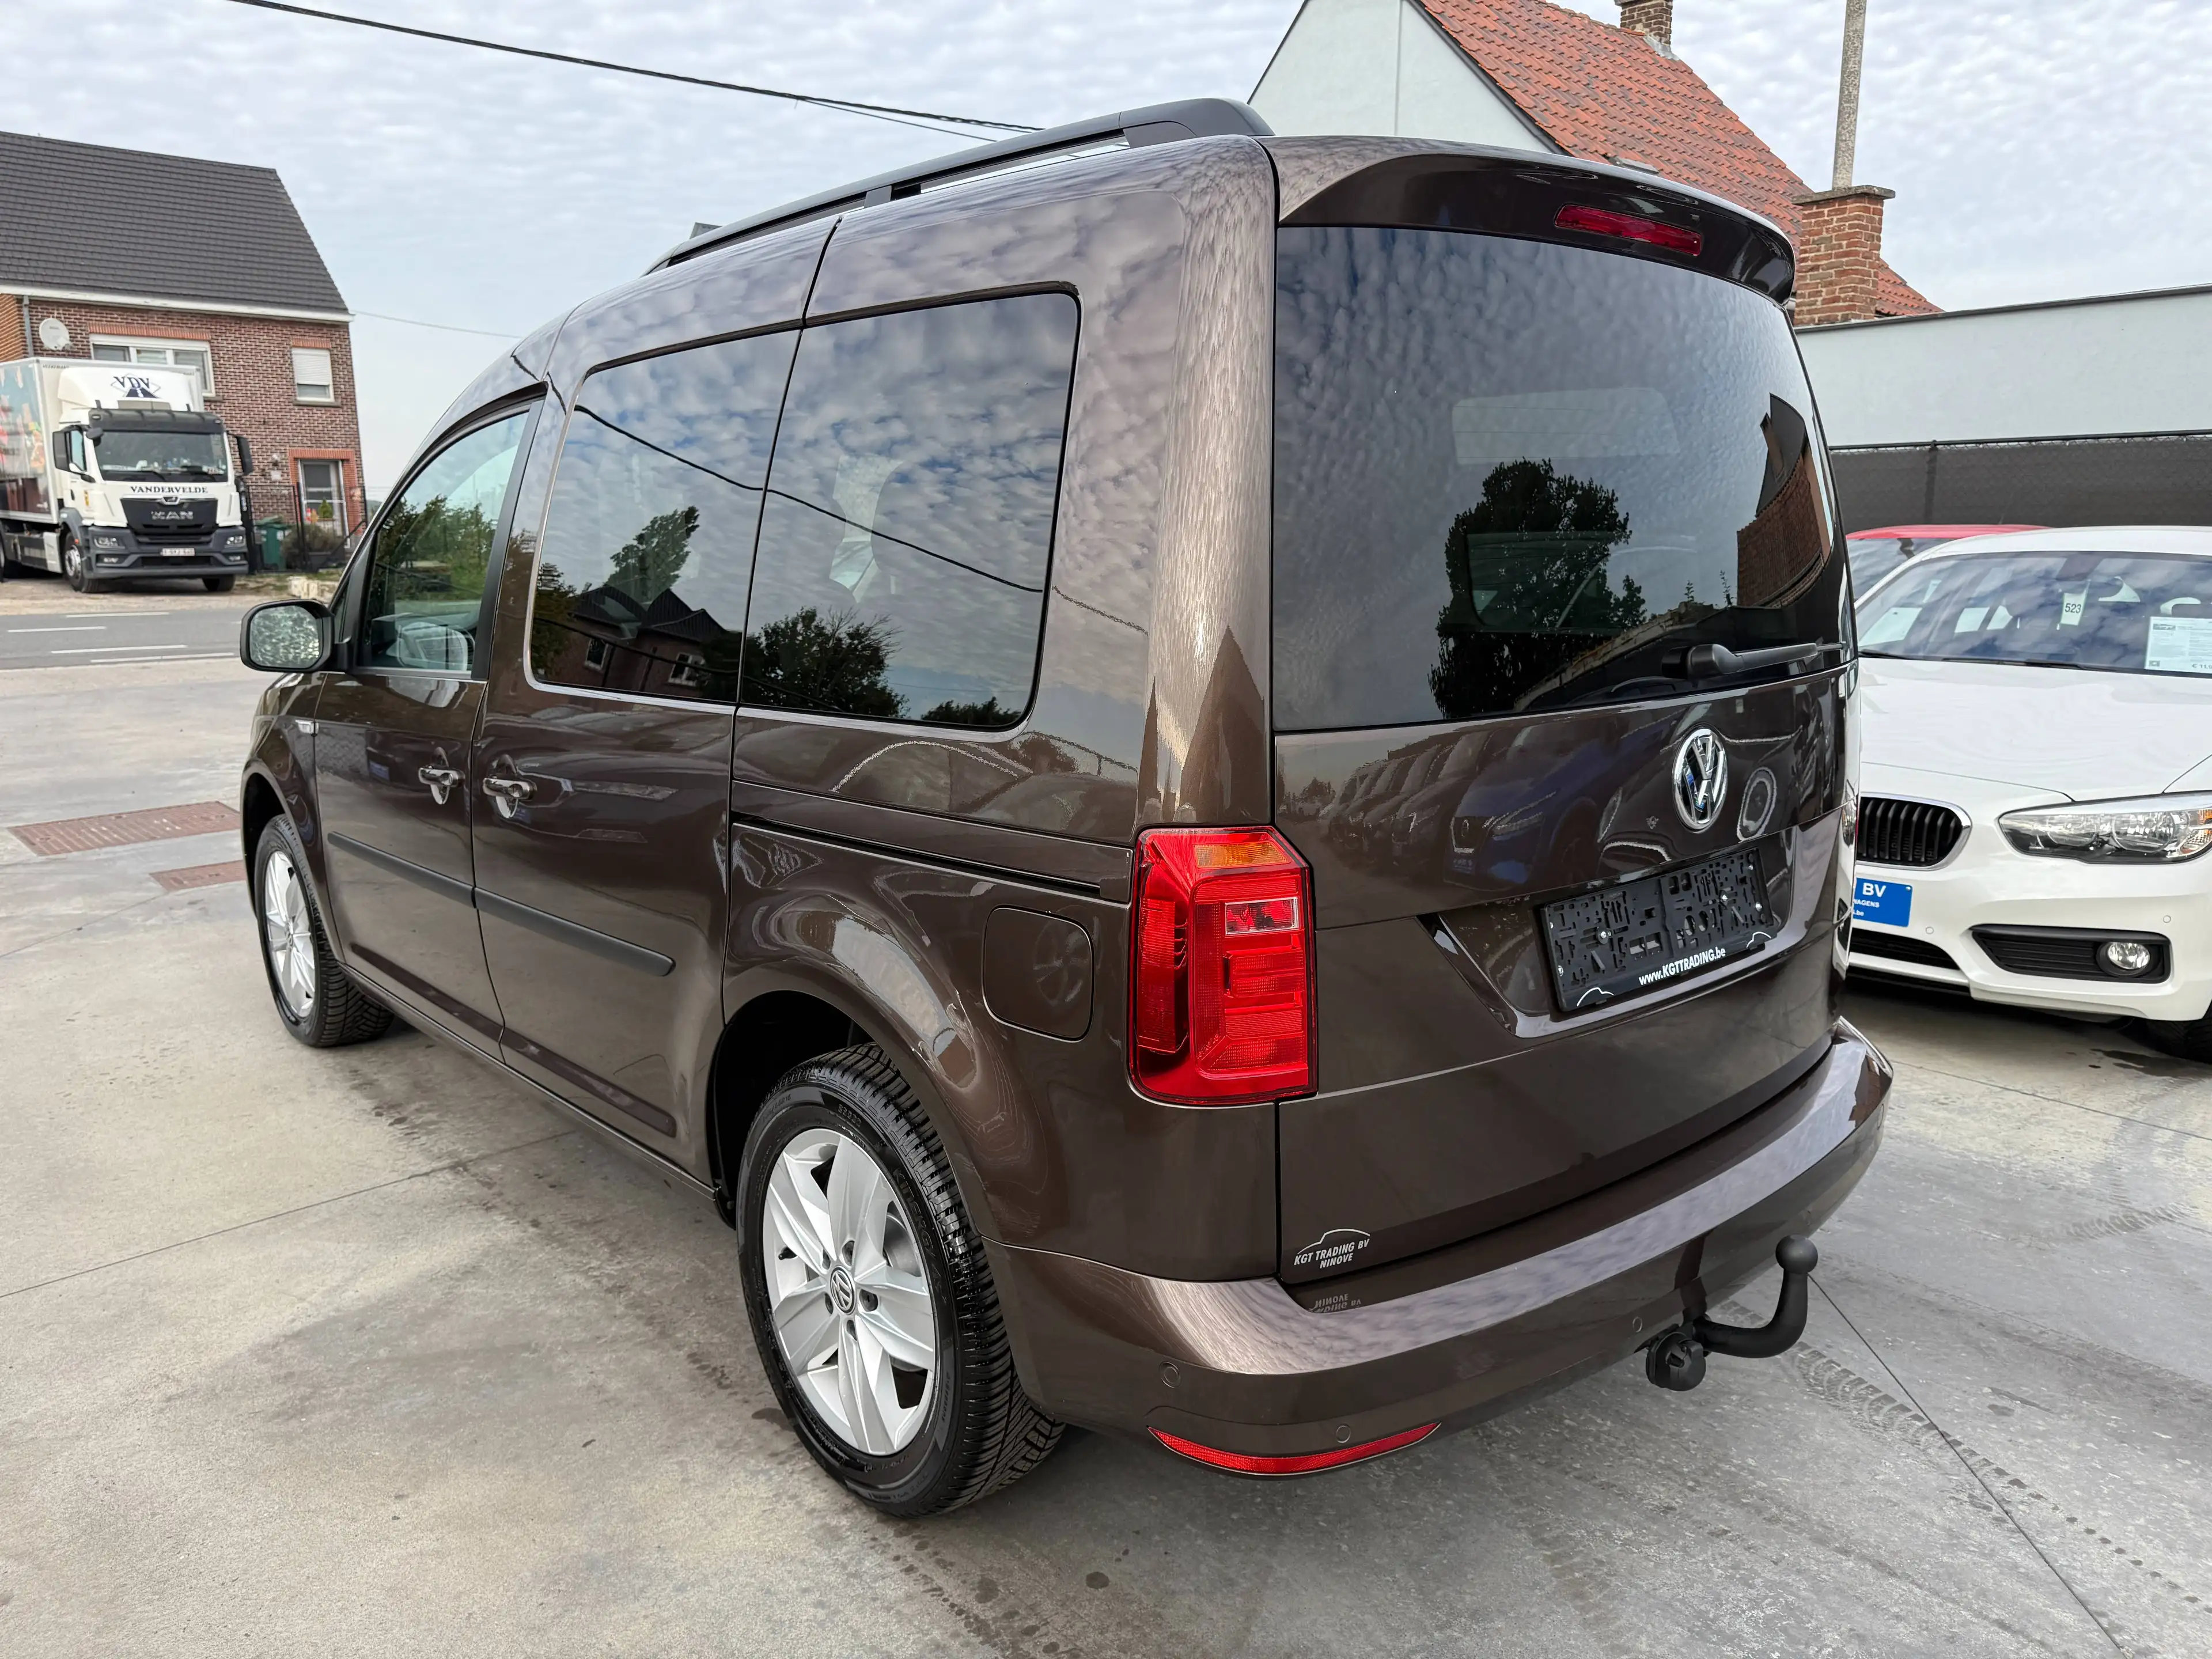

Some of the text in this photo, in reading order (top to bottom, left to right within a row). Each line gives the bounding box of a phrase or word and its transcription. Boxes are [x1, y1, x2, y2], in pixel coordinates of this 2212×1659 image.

[113, 376, 150, 389] VDV
[2065, 603, 2082, 614] 523
[1862, 882, 1887, 897] BV
[1638, 946, 1726, 986] www.KGTTRADING.be
[1294, 1238, 1370, 1266] KGT TRADING BV
[1319, 1252, 1354, 1269] NINOVE
